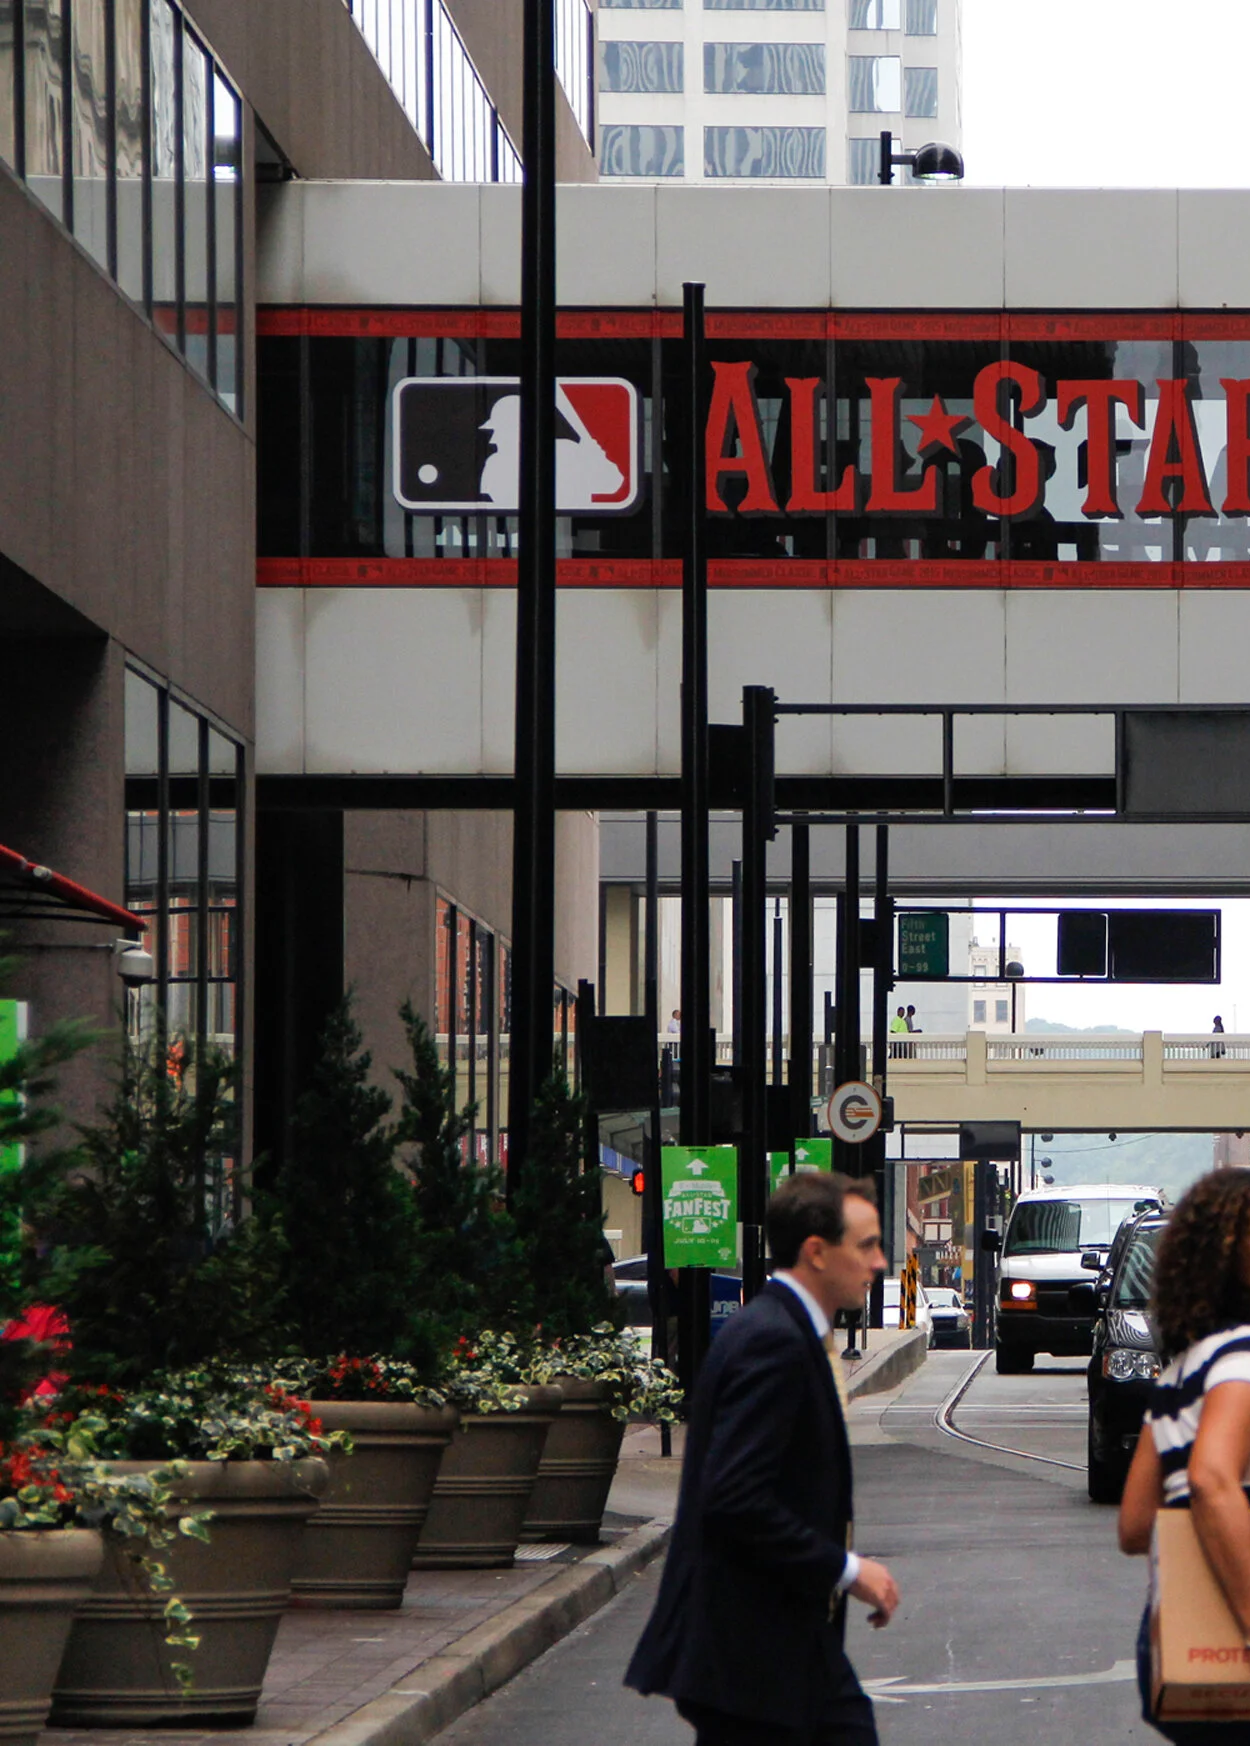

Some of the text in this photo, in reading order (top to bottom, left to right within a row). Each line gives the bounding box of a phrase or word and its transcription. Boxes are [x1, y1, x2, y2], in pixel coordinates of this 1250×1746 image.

[902, 918, 925, 930] Fifth
[902, 931, 936, 942] Street
[902, 943, 926, 954] East
[1188, 1647, 1250, 1663] PROTE
